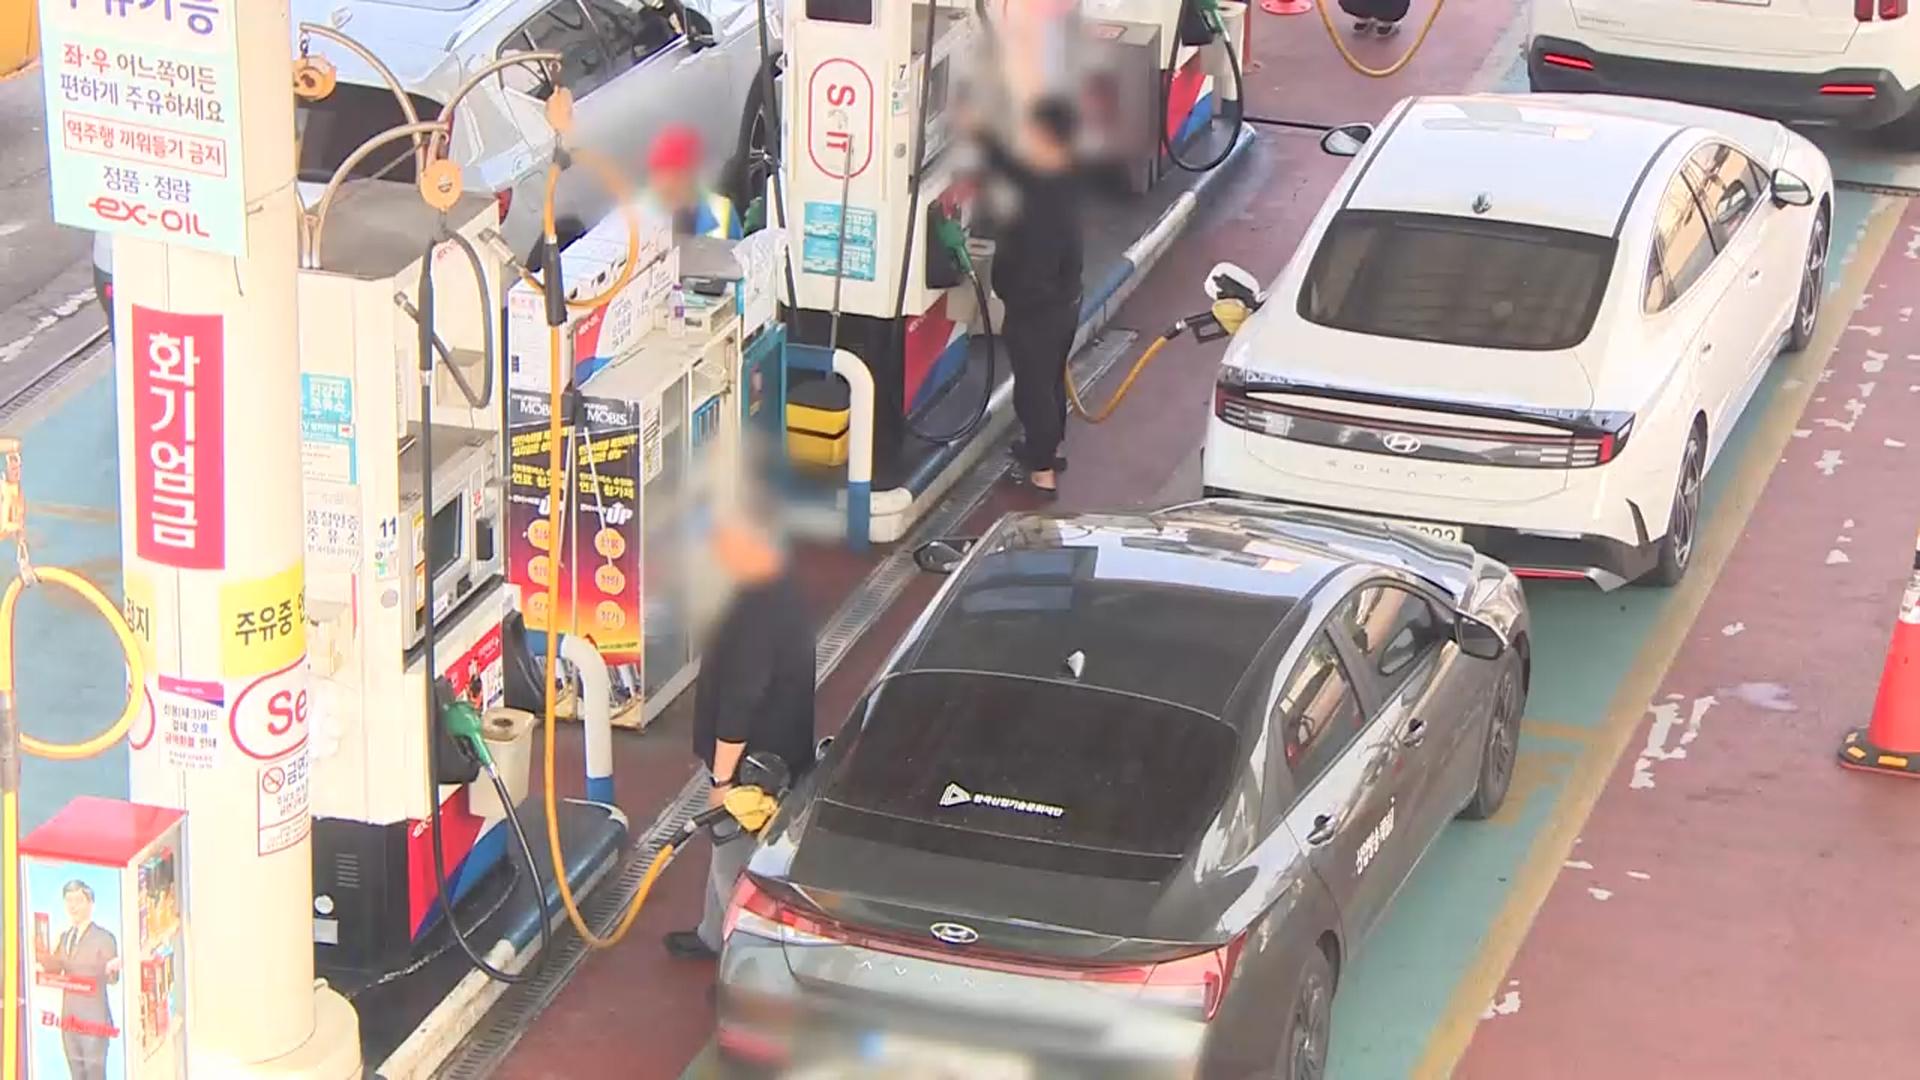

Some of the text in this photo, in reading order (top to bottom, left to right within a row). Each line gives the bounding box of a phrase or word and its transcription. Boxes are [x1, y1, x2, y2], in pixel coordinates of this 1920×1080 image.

[64, 43, 217, 94] 좌·우 어느쪽이든
[899, 64, 907, 80] 7
[61, 74, 224, 123] 편하게 주유하세요
[67, 119, 221, 165] 역주행 끼워들기 금지
[519, 401, 551, 416] MOB
[587, 410, 627, 426] MOBIS
[149, 331, 200, 549] 화기엄금
[380, 516, 397, 538] 11
[606, 502, 633, 525] UP
[235, 599, 293, 646] 주유중
